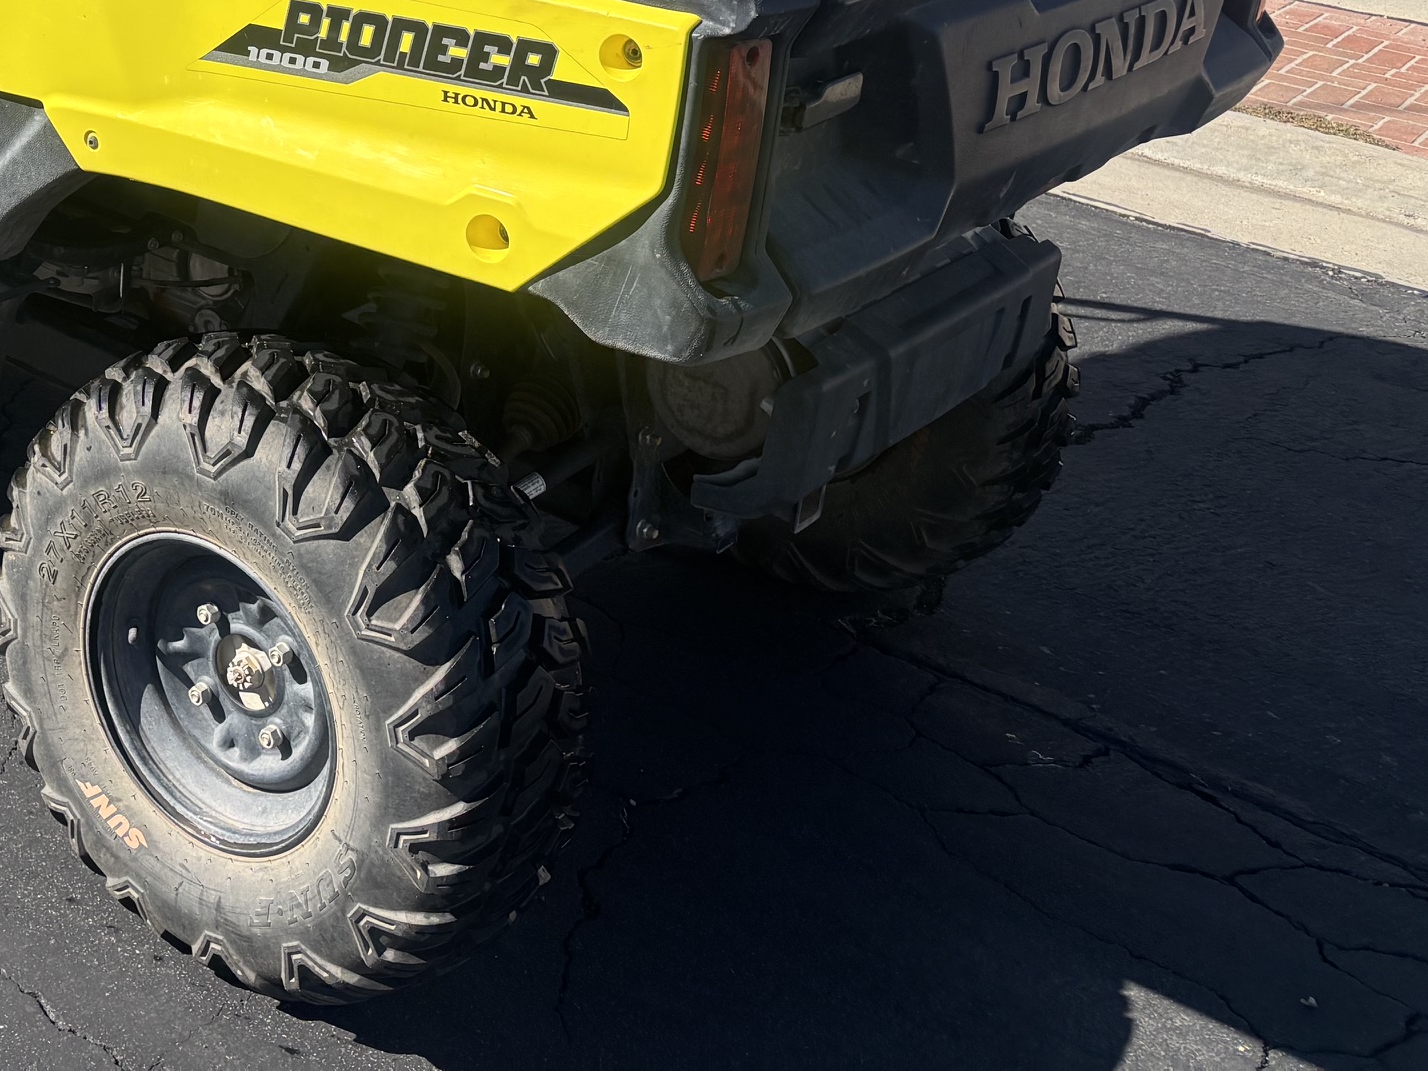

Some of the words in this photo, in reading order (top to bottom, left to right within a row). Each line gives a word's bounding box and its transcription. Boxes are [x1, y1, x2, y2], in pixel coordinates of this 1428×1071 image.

[247, 45, 329, 74] 1000
[441, 89, 538, 120] HONDA
[38, 480, 152, 585] 27X11R12
[75, 779, 148, 849] SUNF
